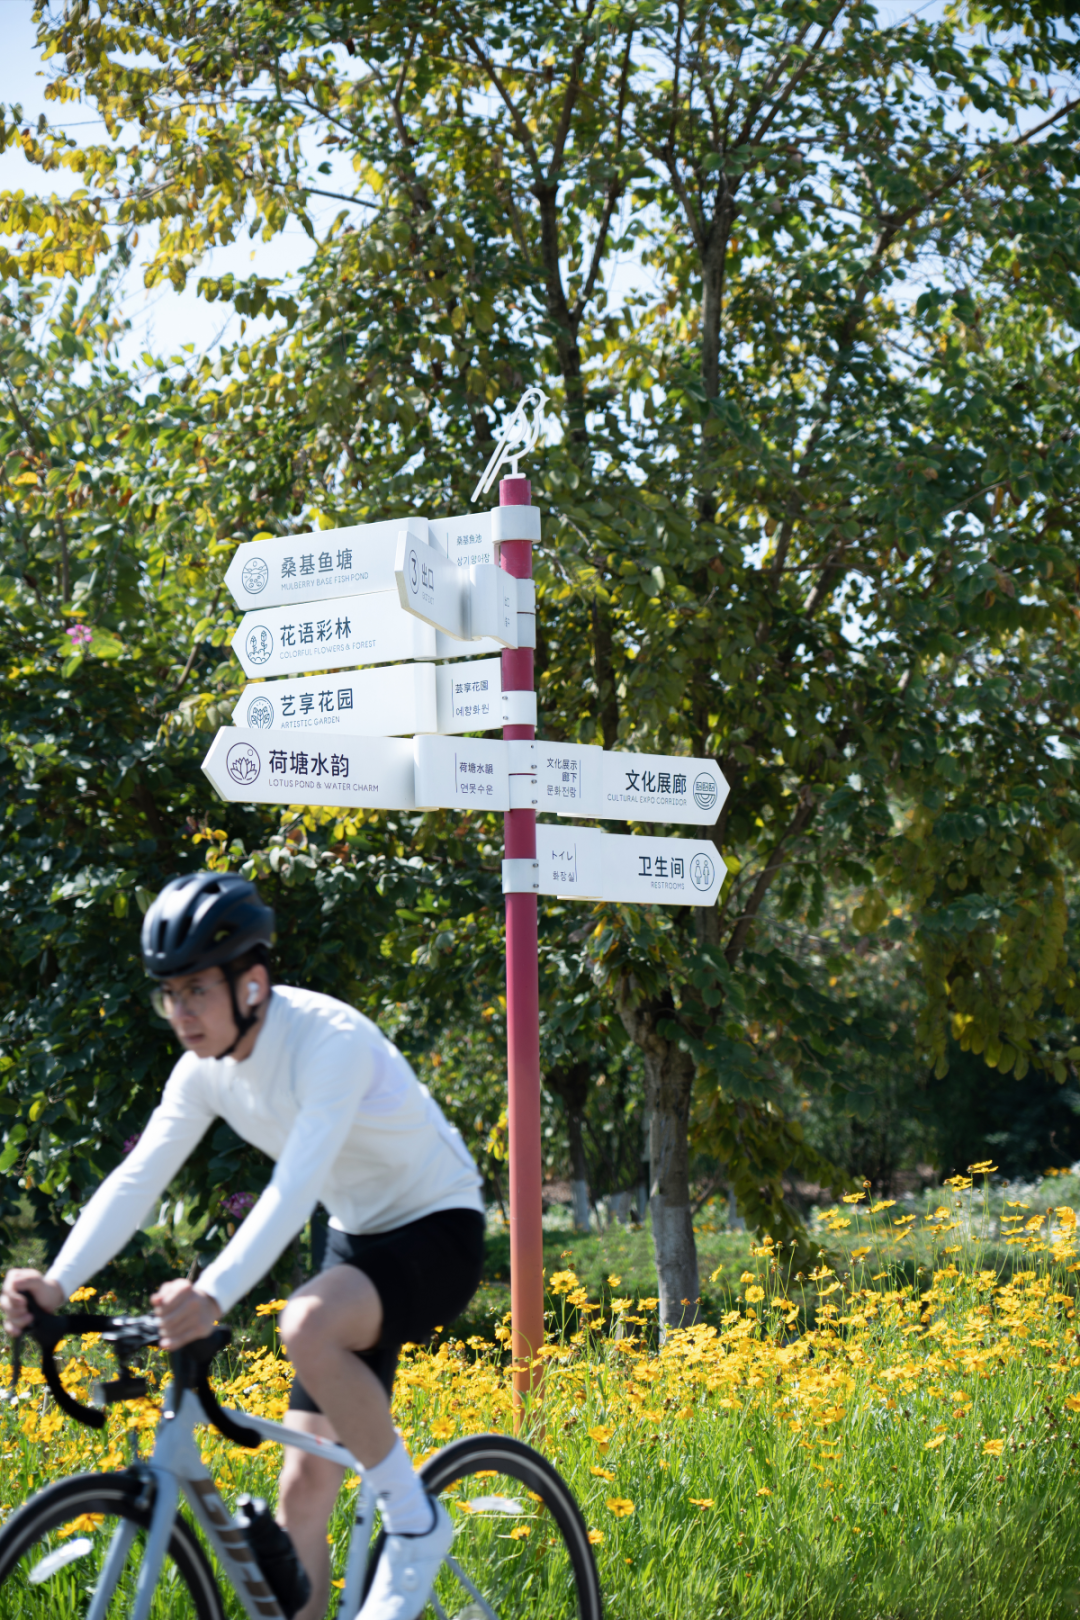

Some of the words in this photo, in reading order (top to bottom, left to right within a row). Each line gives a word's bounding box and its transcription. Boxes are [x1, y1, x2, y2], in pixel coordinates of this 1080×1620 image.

[281, 548, 352, 578] 桑基鱼塘
[281, 580, 314, 590] MULBERRY
[316, 577, 332, 586] BASE
[334, 575, 350, 584] FISH
[351, 572, 368, 582] POND
[422, 563, 434, 591] 出口
[280, 616, 351, 646] 花语彩林
[280, 648, 312, 660] COLORFUL
[314, 644, 344, 654] FLOWERS
[352, 640, 376, 650] FOREST
[280, 688, 353, 716] 艺享花园
[281, 718, 312, 729] ARTISTIC
[314, 716, 340, 726] GARDEN
[269, 750, 349, 778] 荷塘水韵
[546, 758, 578, 770] 文化展示
[269, 778, 294, 788] LOTUS
[294, 780, 314, 789] POND
[324, 782, 350, 791] WATER
[352, 784, 378, 792] CHARM
[625, 769, 687, 795] 文化展廊
[607, 794, 638, 802] CULTURAL
[640, 796, 654, 804] EXPO
[656, 797, 688, 806] CORRIDOR
[552, 850, 574, 860] トイレ
[638, 856, 684, 879] 卫生间
[650, 882, 684, 890] RESTROOMS
